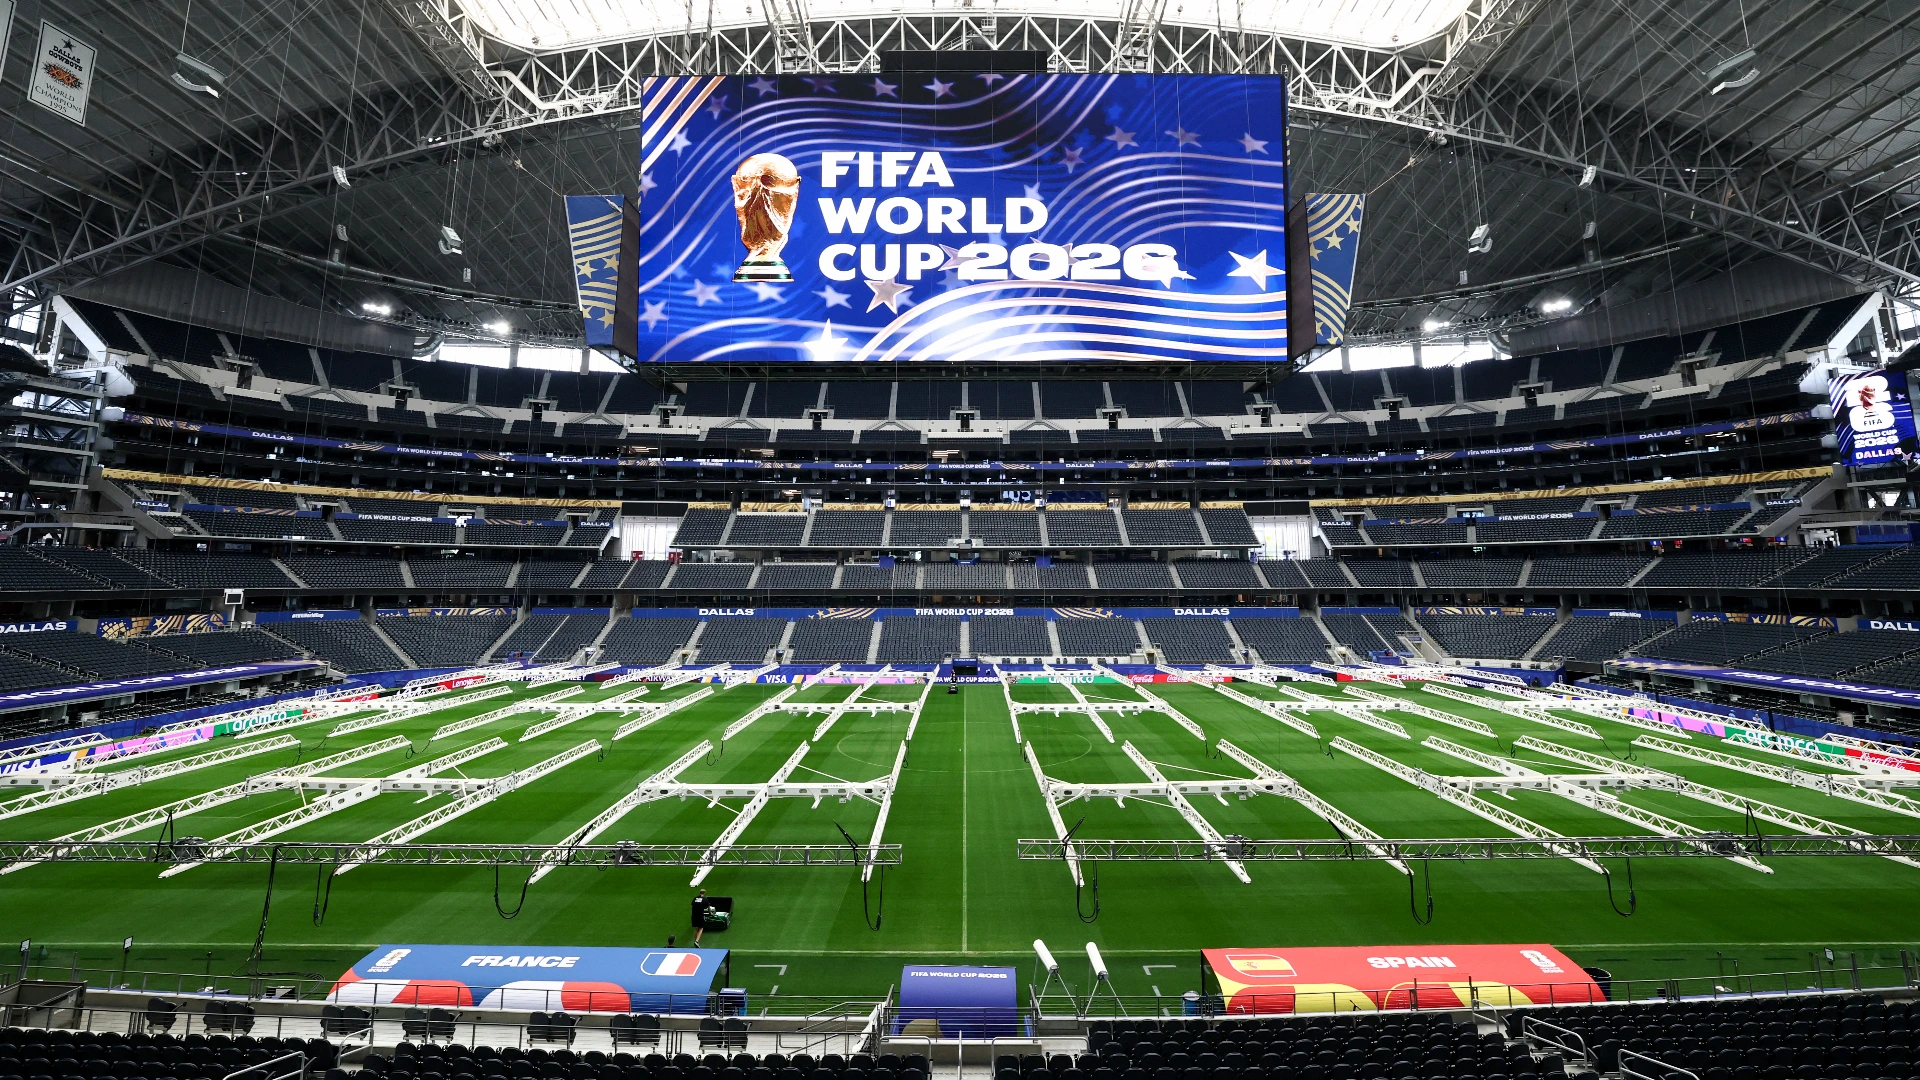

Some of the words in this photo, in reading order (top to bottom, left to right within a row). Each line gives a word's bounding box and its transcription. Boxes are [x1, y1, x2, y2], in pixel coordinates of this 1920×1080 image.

[53, 45, 81, 63] DALLAS
[48, 50, 83, 72] COWBOYS
[46, 82, 75, 102] WORLD
[34, 85, 82, 114] CHAMPIONS
[49, 100, 67, 113] 1995
[820, 151, 955, 188] FIFA
[818, 197, 1048, 234] WORLD
[818, 243, 945, 281] CUP
[957, 243, 1179, 281] 2026
[1863, 418, 1883, 427] FIFA
[252, 431, 294, 441] DALLAS
[1639, 429, 1682, 440] DALLAS
[1853, 430, 1880, 440] WORLD
[1881, 428, 1898, 437] CUP
[1853, 435, 1900, 449] 2026
[1855, 447, 1902, 460] DALLAS
[698, 608, 755, 616] DALLAS
[915, 608, 934, 616] FIFA
[934, 608, 967, 616] WORLD
[967, 608, 983, 616] CUP
[984, 608, 1014, 616] 2026
[1174, 608, 1231, 616] DALLAS
[764, 674, 788, 684] VISA
[1782, 678, 1897, 696] WORLD
[232, 710, 288, 732] aramco
[461, 955, 581, 968] FRANCE
[1366, 956, 1457, 969] SPAIN
